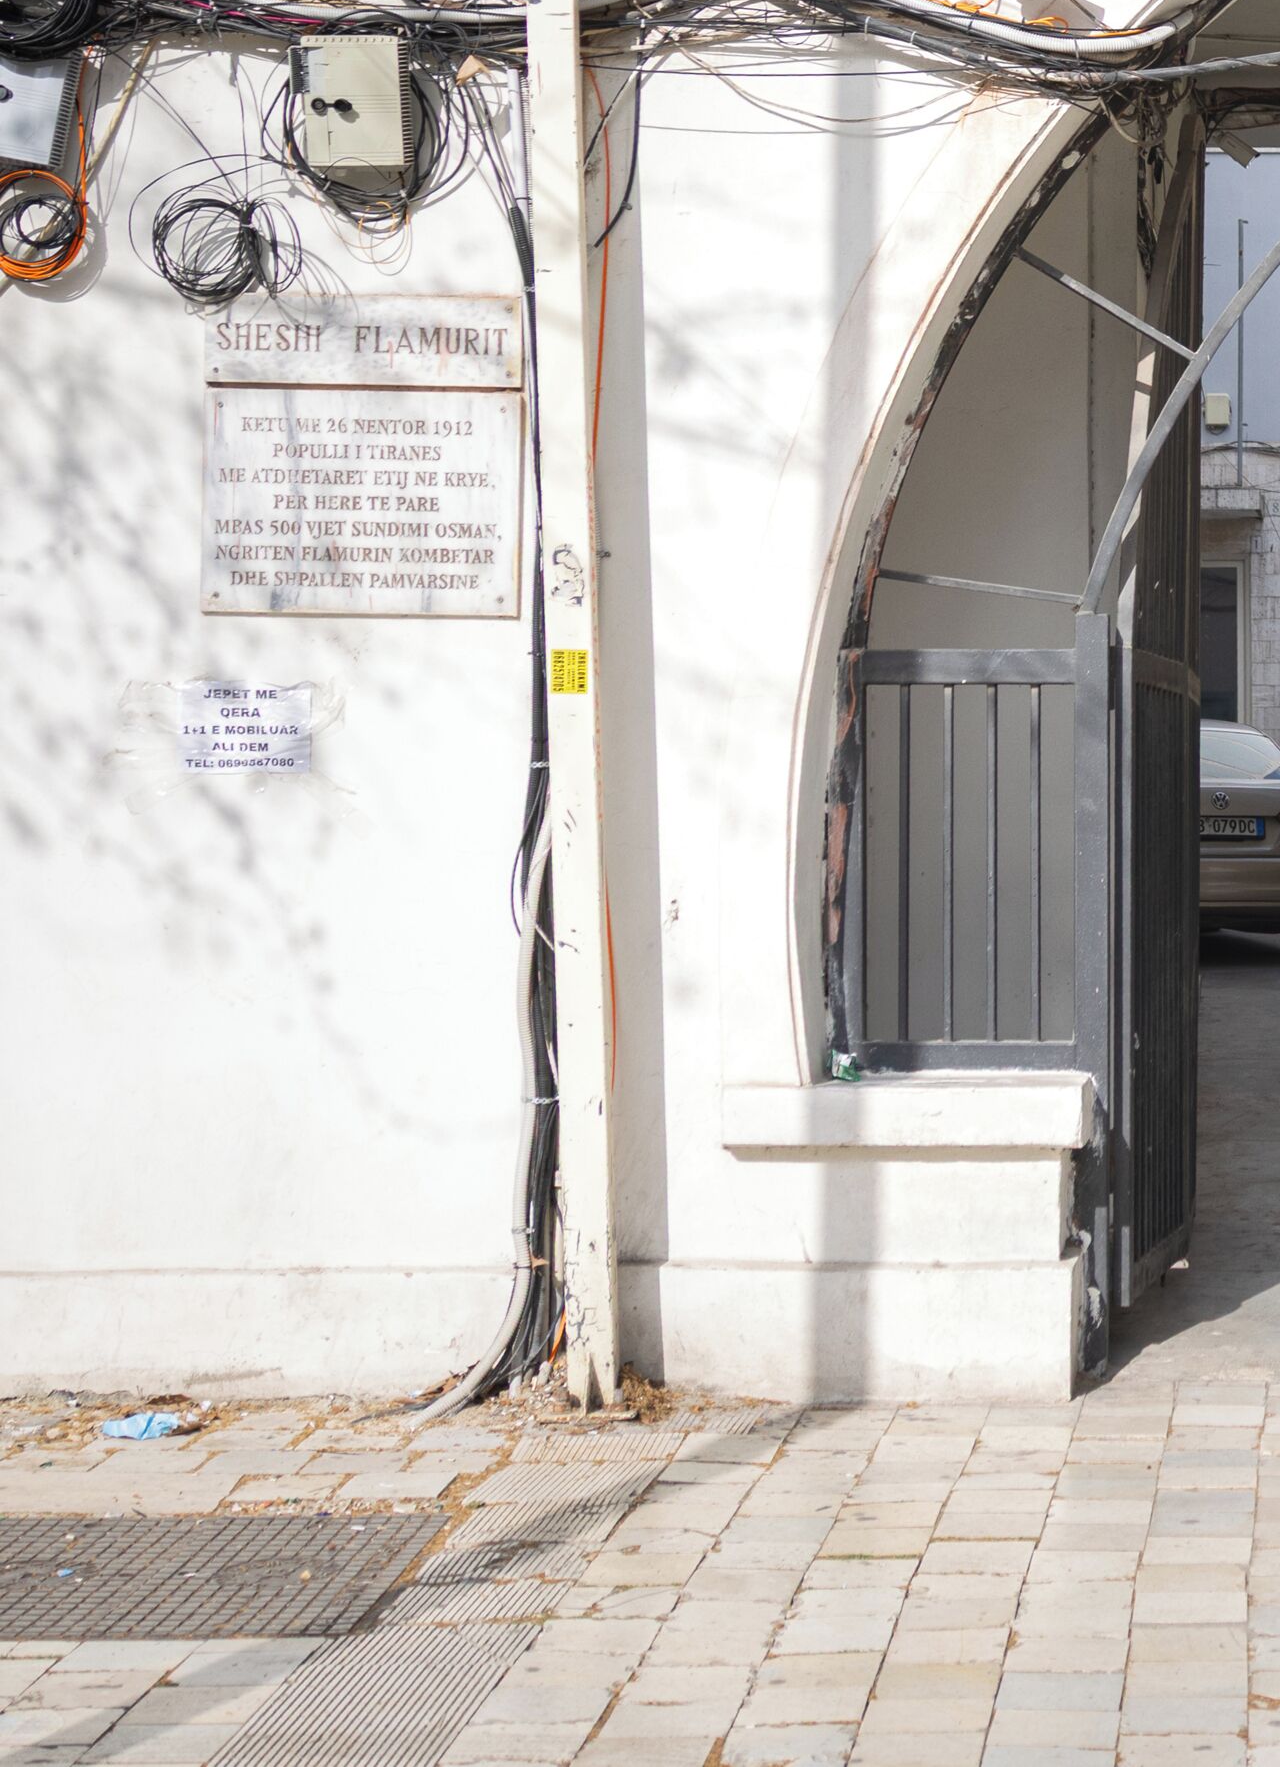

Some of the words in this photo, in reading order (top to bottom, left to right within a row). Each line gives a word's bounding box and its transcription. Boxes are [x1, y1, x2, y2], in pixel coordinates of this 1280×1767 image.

[216, 322, 321, 352] SHESHI
[354, 325, 508, 356] FLAMURIT
[241, 416, 288, 432] KETU
[295, 418, 321, 433] ME
[327, 419, 347, 434] 26
[353, 419, 427, 435] NENTOR
[433, 420, 473, 437] 1912
[272, 443, 349, 459] POPULLI
[355, 445, 361, 460] I
[219, 467, 246, 483] ME
[414, 471, 438, 486] NE
[273, 495, 309, 510] PER
[315, 495, 362, 511] HERE
[367, 496, 390, 511] TE
[395, 497, 440, 512] PARE
[215, 519, 264, 534] MBAS
[270, 520, 301, 536] 500
[306, 521, 347, 540] VJET
[352, 522, 429, 537] SUNDIMI
[435, 523, 502, 542] OSMAN,
[214, 545, 296, 561] NGRITEN
[301, 546, 393, 563] FLAMURIN
[399, 548, 494, 564] KOMBETAR
[230, 571, 269, 586] DHE
[274, 571, 364, 587] SHPALLEN
[369, 574, 480, 590] PAMVARSINE
[203, 689, 251, 700] JEPET
[255, 690, 278, 700] ME
[220, 707, 261, 718] QERA
[183, 725, 207, 735] 1+1
[212, 725, 220, 735] E
[224, 725, 299, 735] MOBILUAR
[212, 742, 235, 752] ALI
[239, 742, 269, 752] DEM
[185, 758, 214, 768] TEL:
[1213, 819, 1255, 834] 079DC
